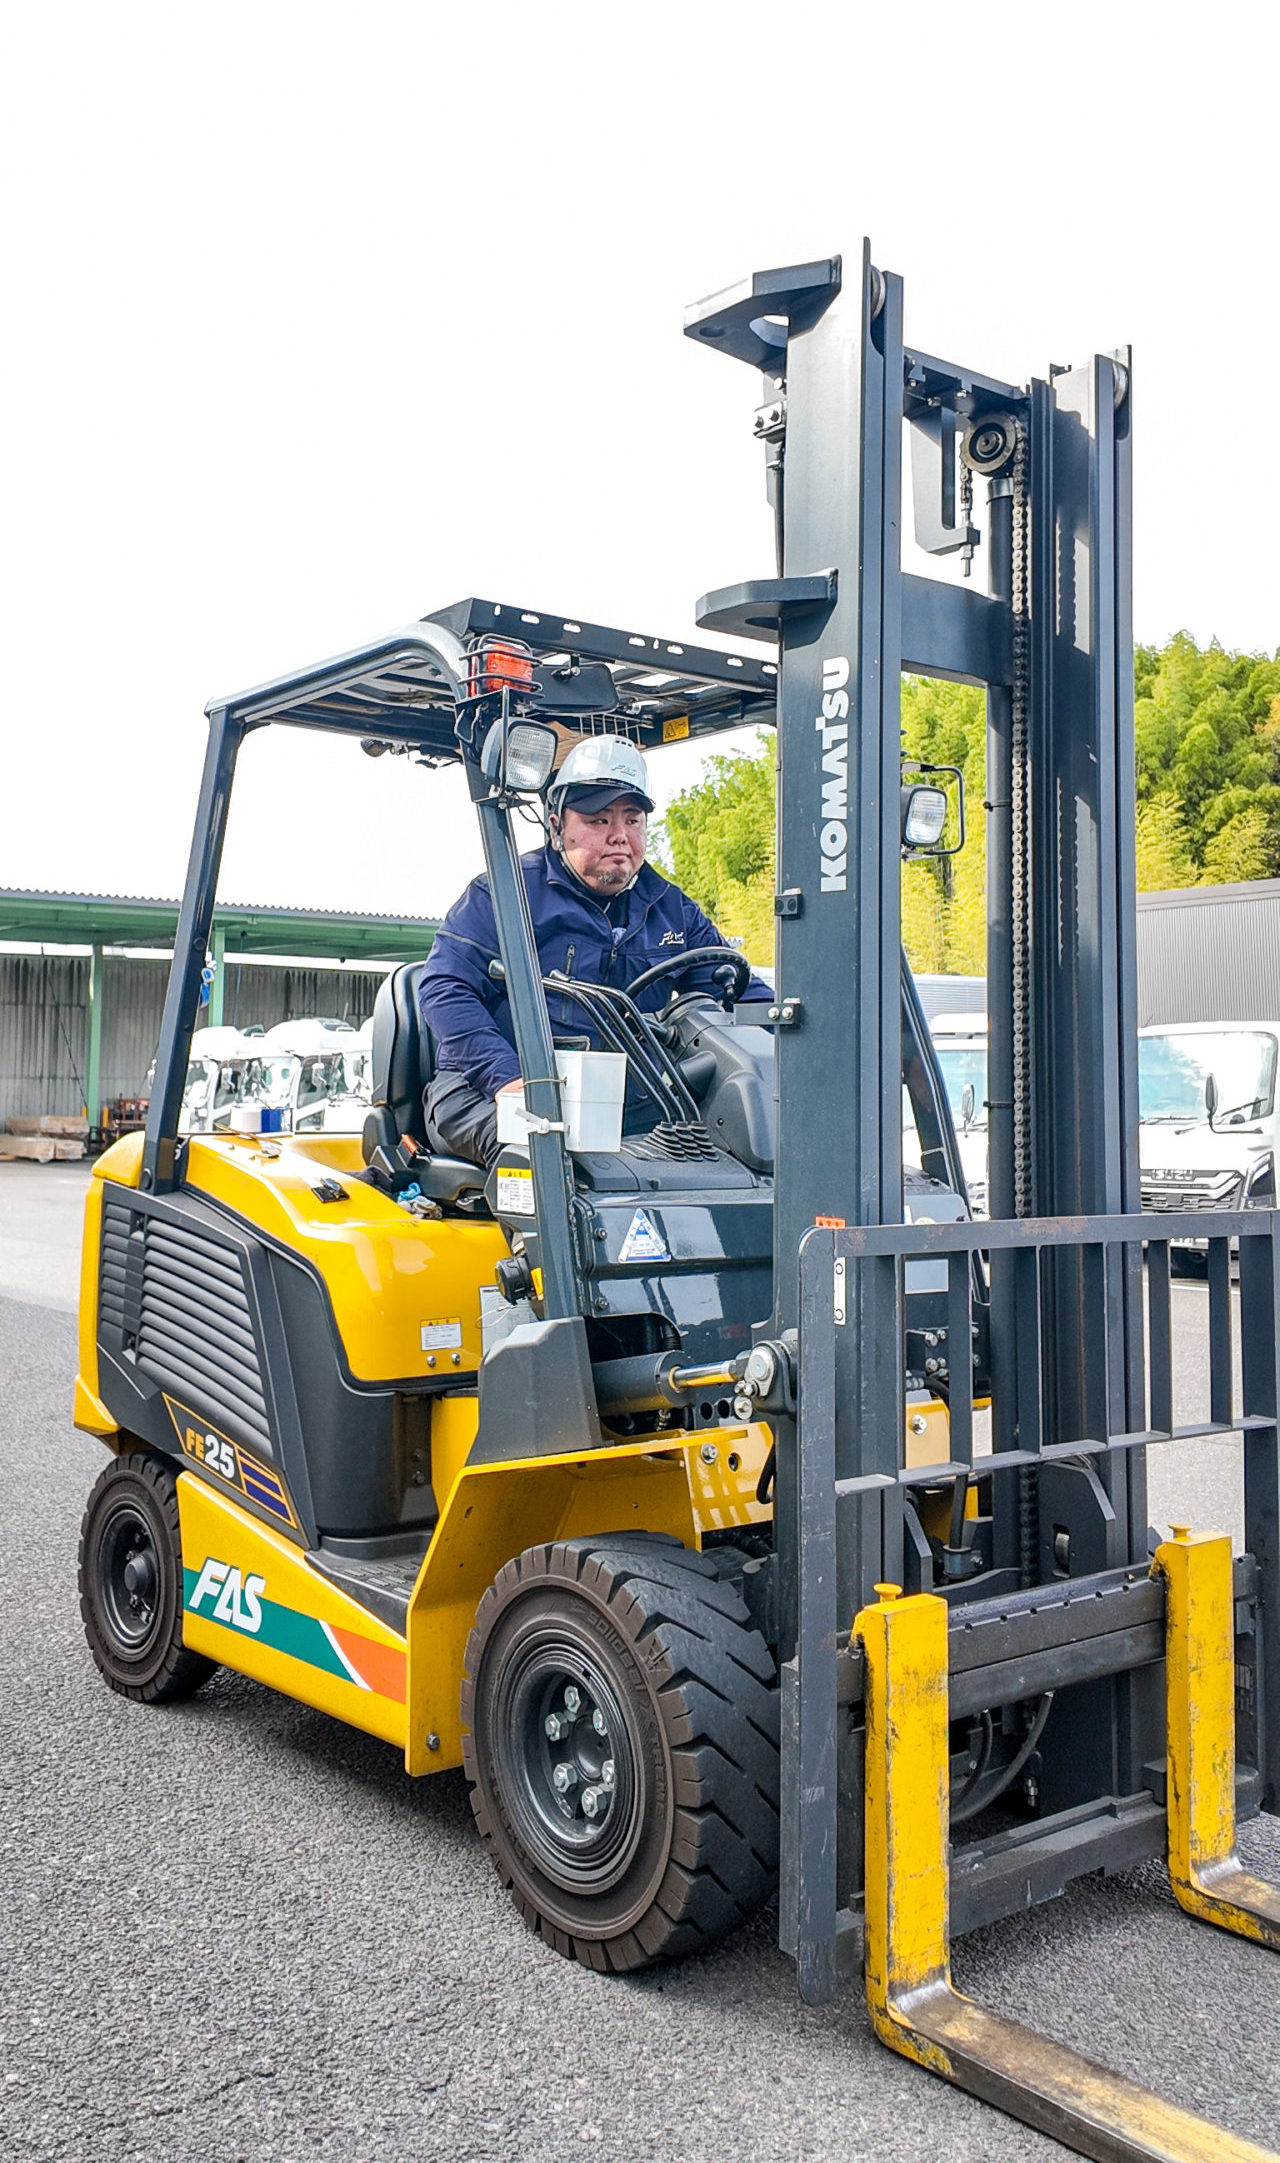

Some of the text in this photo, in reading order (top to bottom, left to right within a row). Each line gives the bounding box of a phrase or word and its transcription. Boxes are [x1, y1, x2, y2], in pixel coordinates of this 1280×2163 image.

[815, 656, 850, 893] KOMATSU
[1151, 1169, 1194, 1180] ISUZU
[185, 1426, 235, 1479] FE25
[188, 1557, 266, 1633] FAS
